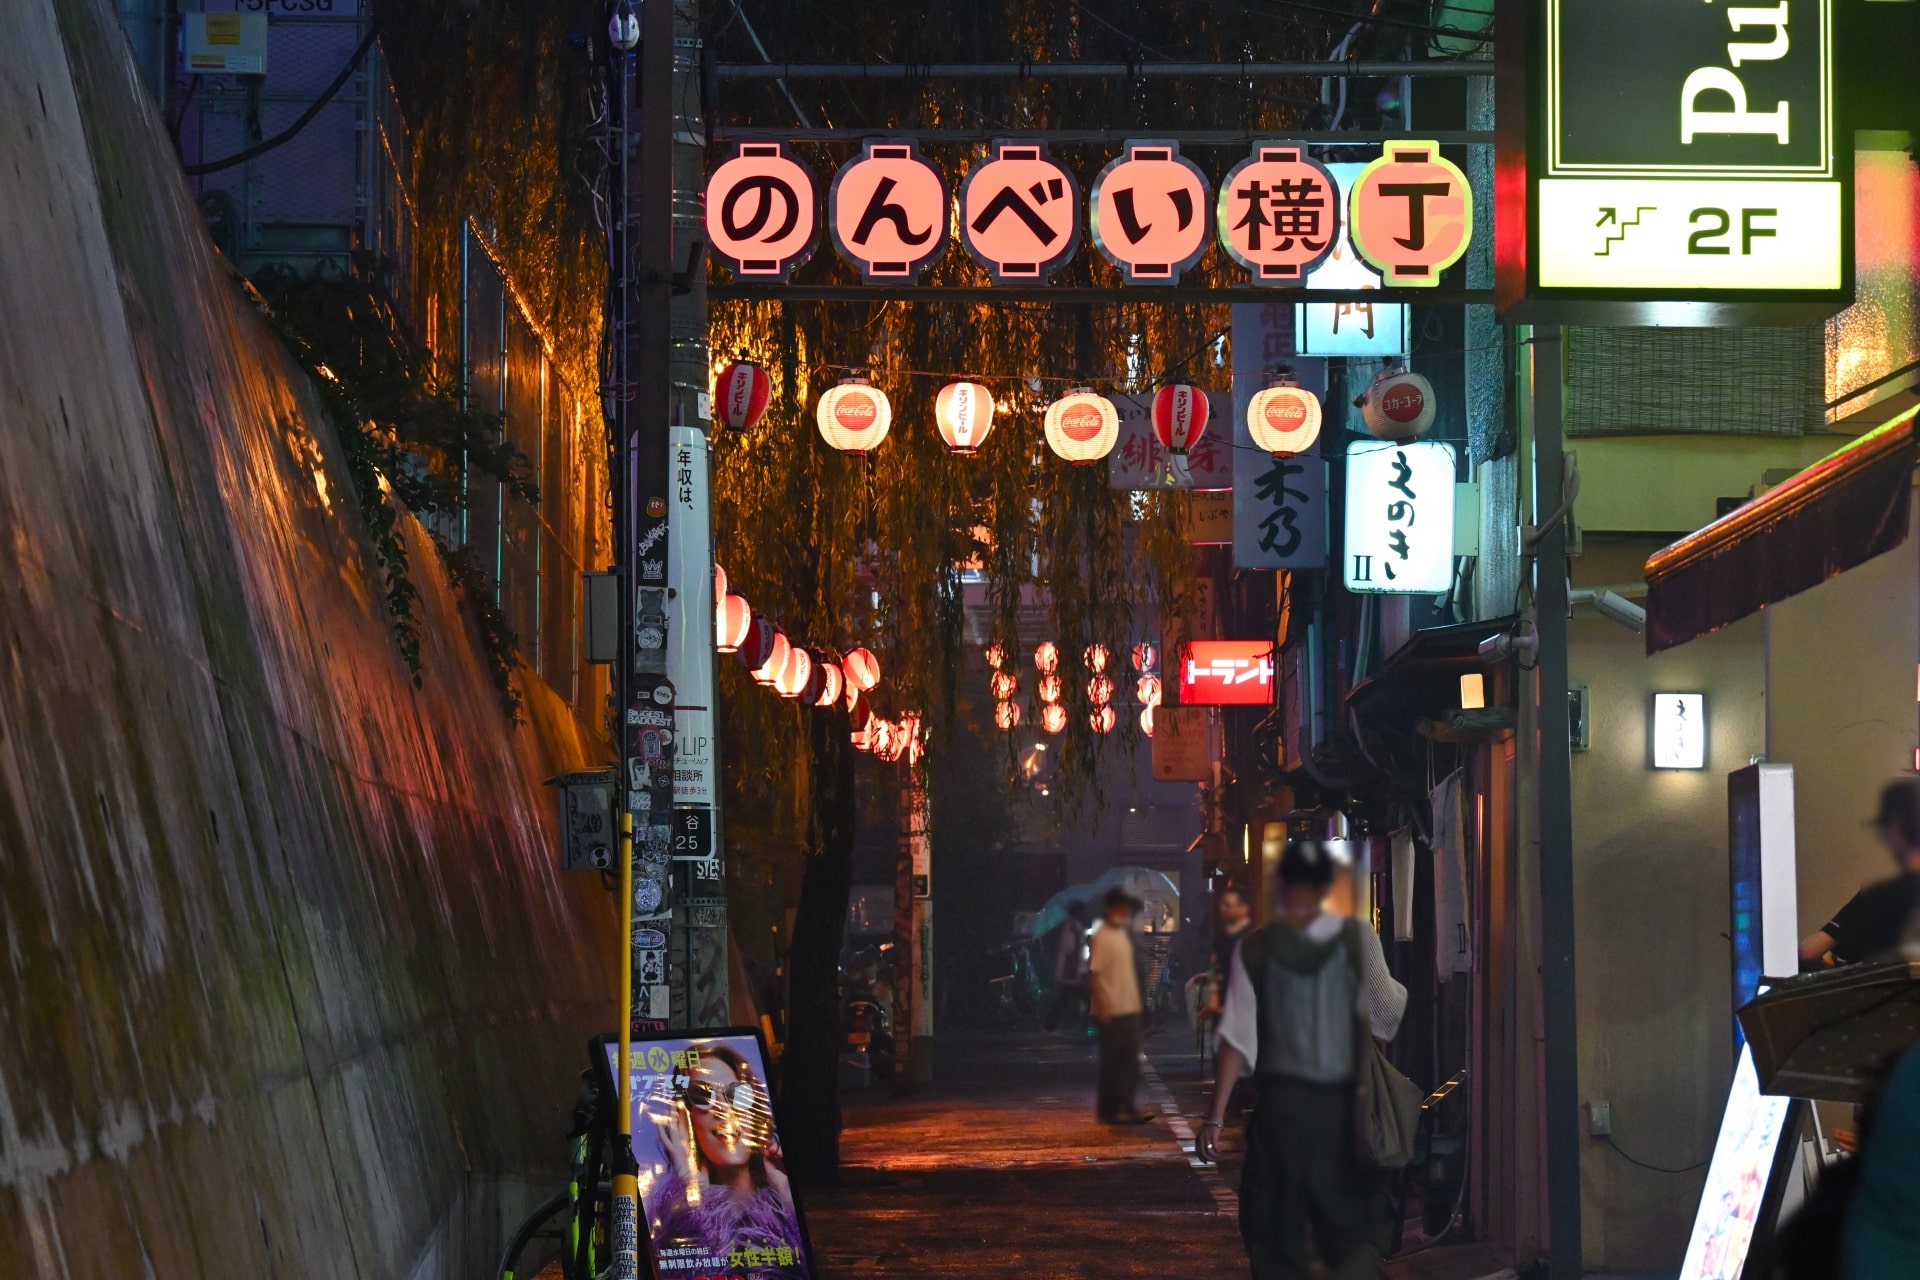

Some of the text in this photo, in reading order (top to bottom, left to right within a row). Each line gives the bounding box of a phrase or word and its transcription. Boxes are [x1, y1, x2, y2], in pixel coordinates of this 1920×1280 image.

[1681, 0, 1789, 144] Pu
[721, 175, 1451, 251] のんべい横丁
[1687, 207, 1778, 255] 2F
[733, 372, 747, 416] キリンビール
[836, 404, 873, 417] Coca-Cola
[959, 389, 968, 434] キリンビール
[1175, 391, 1188, 436] キリンビール
[1267, 406, 1304, 418] Coca-Cola
[1063, 414, 1099, 428] Coca-Cola
[628, 709, 664, 718] BIGGEST
